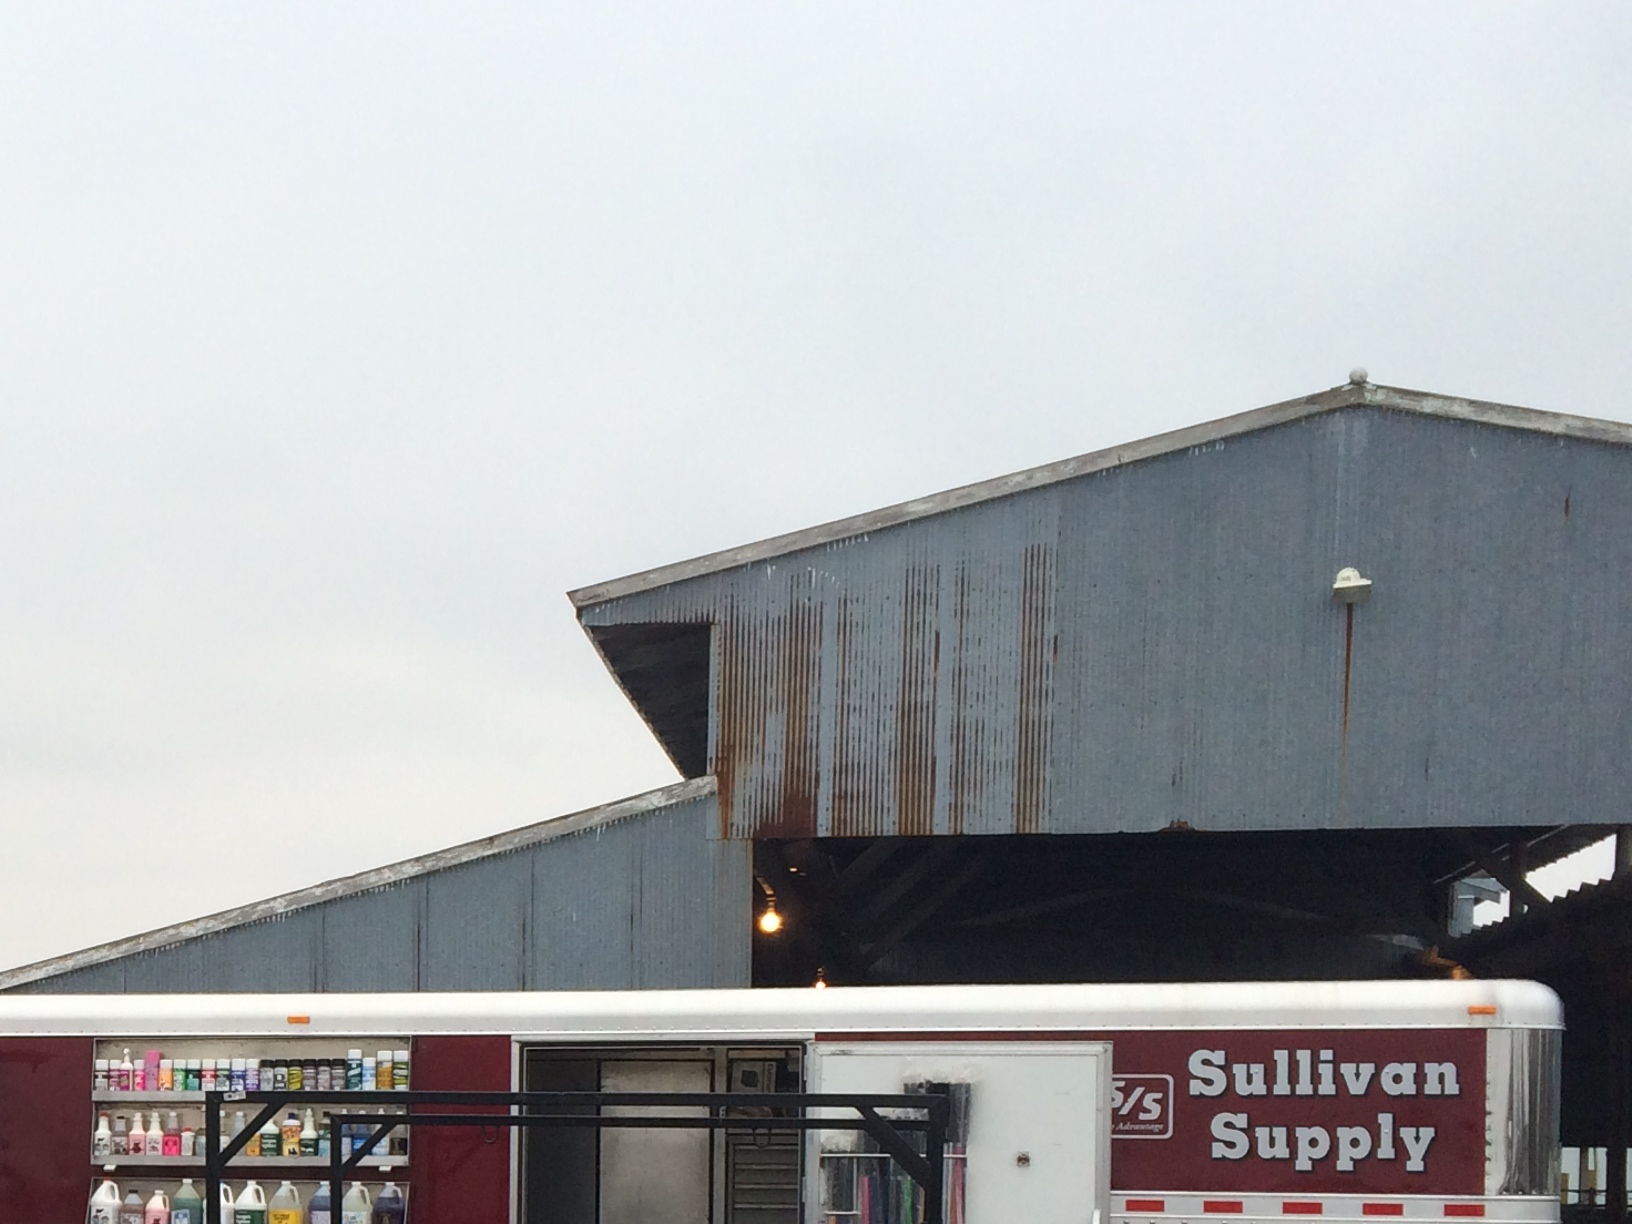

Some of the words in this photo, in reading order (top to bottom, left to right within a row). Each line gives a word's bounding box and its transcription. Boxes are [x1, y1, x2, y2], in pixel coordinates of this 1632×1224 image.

[1188, 1049, 1460, 1096] Sullivan
[1115, 1121, 1165, 1133] Advantage
[1210, 1112, 1436, 1171] Supply
